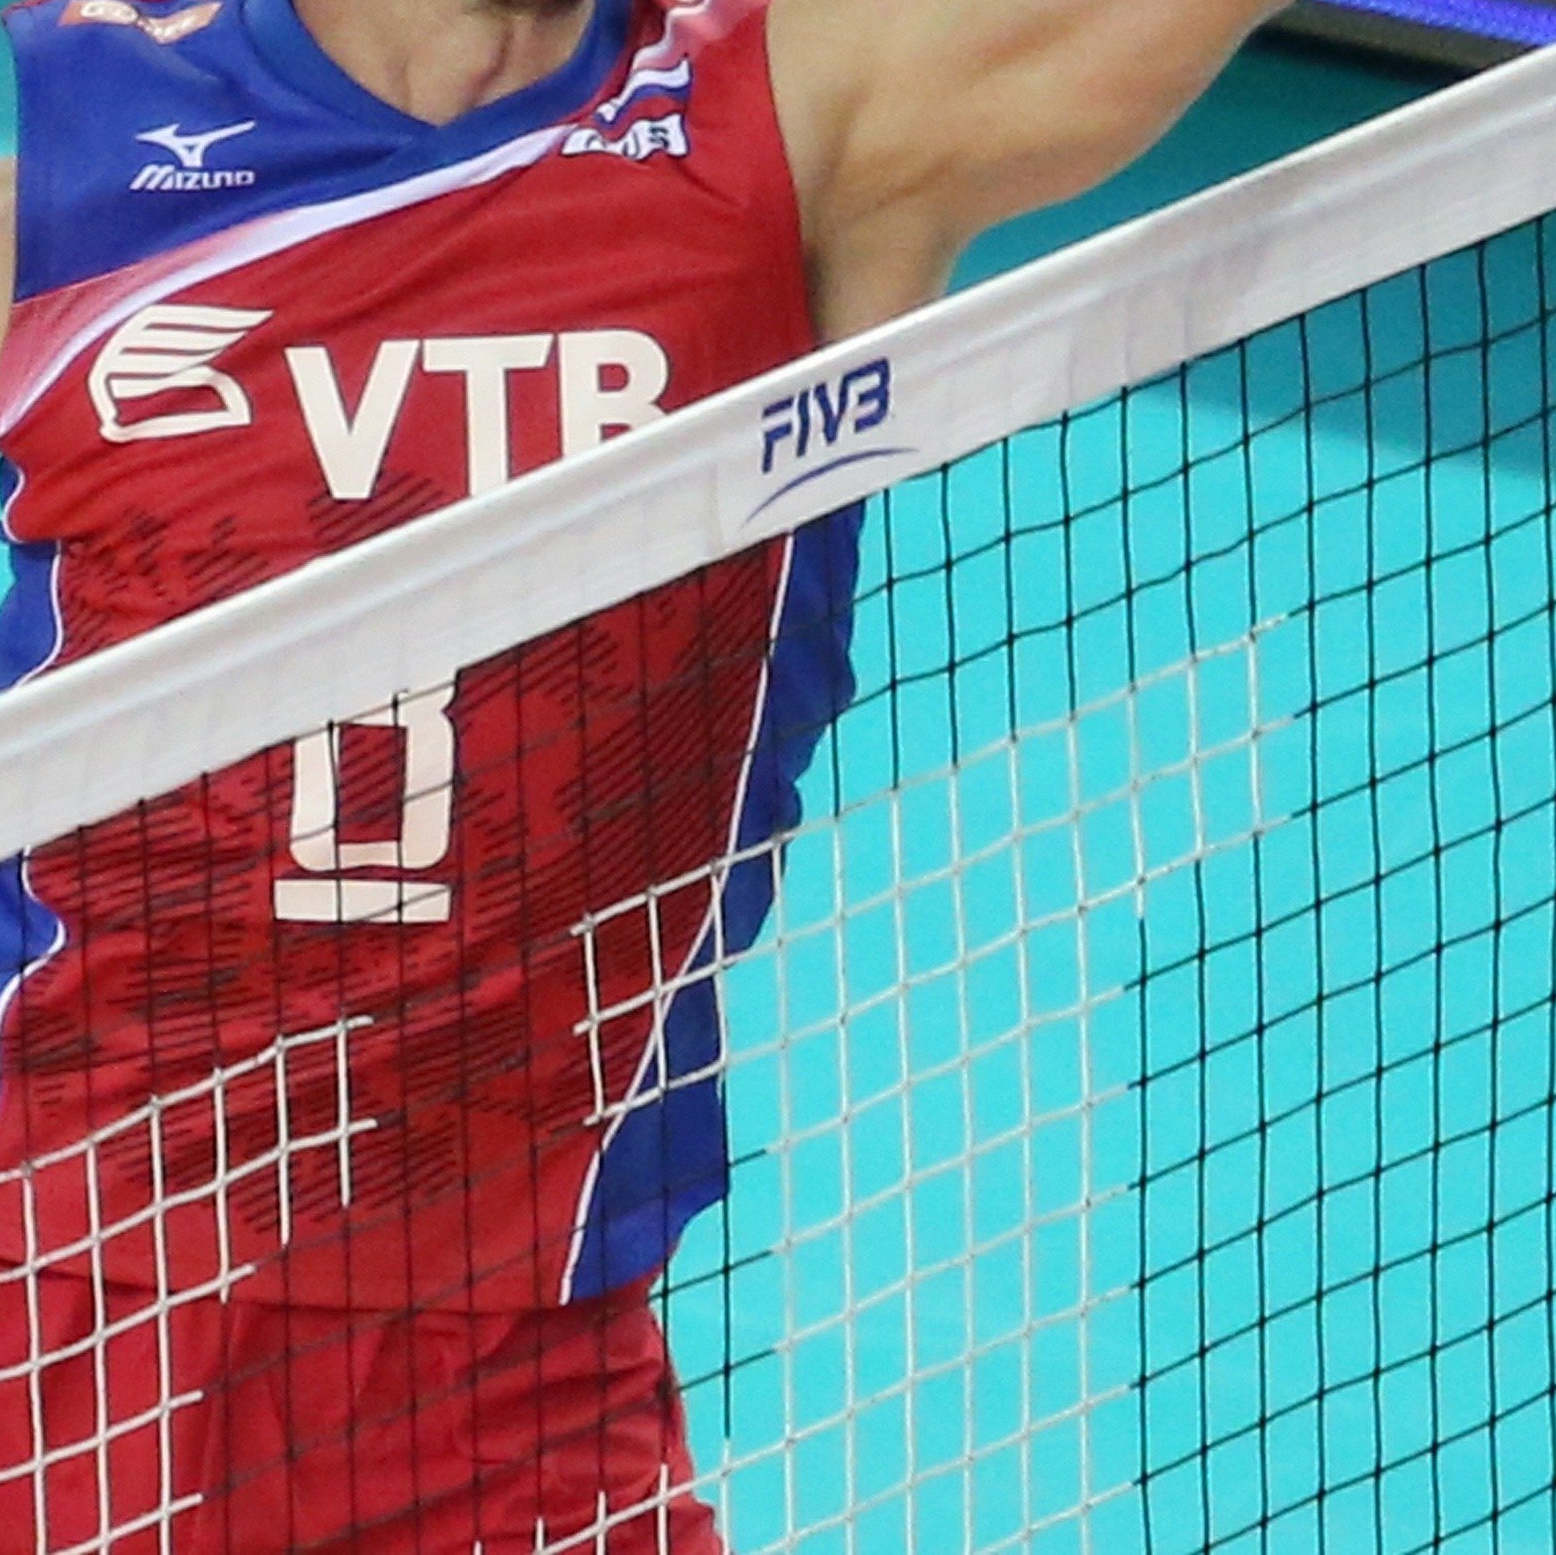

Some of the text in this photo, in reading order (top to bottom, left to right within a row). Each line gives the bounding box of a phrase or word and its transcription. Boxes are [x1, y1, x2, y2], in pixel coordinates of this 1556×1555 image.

[130, 164, 256, 190] MIZUNO
[283, 328, 671, 500] VTB
[762, 357, 891, 474] FIVB
